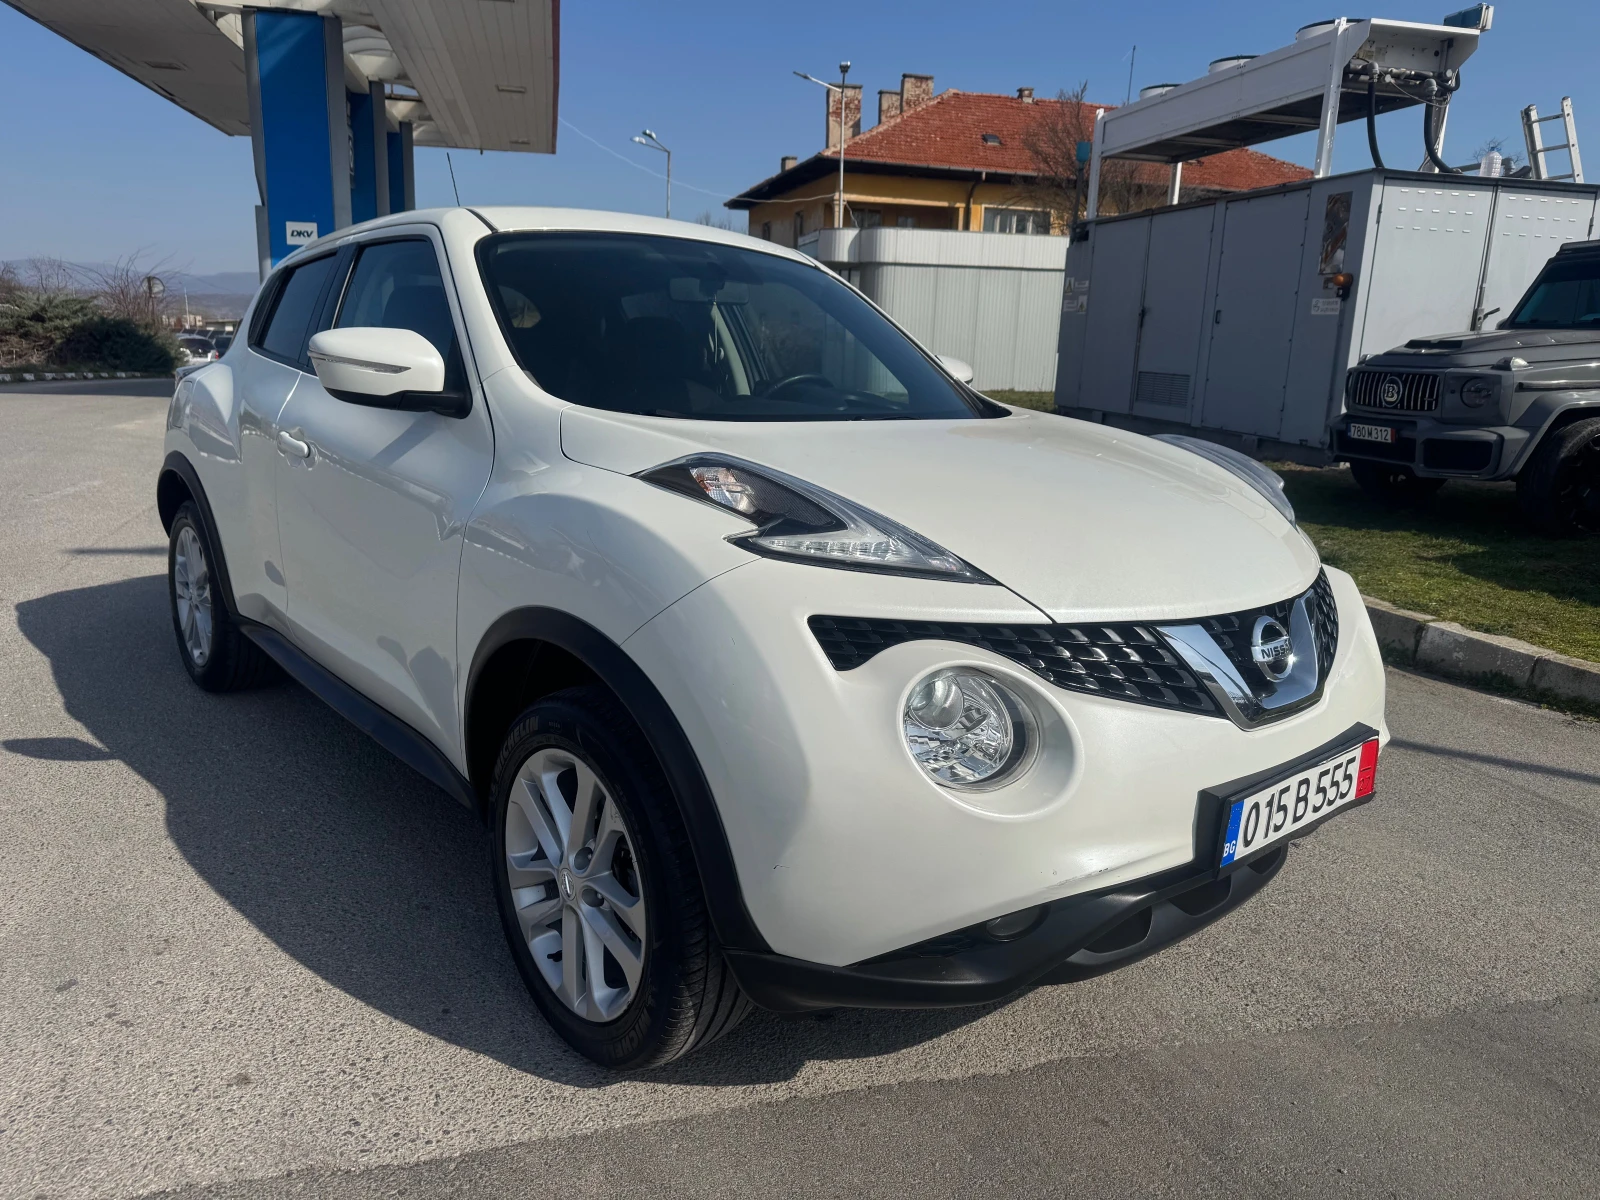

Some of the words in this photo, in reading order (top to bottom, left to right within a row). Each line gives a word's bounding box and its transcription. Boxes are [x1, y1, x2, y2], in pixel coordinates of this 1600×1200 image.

[290, 229, 314, 239] DKV
[1261, 640, 1288, 660] NISS
[1223, 840, 1236, 857] BG
